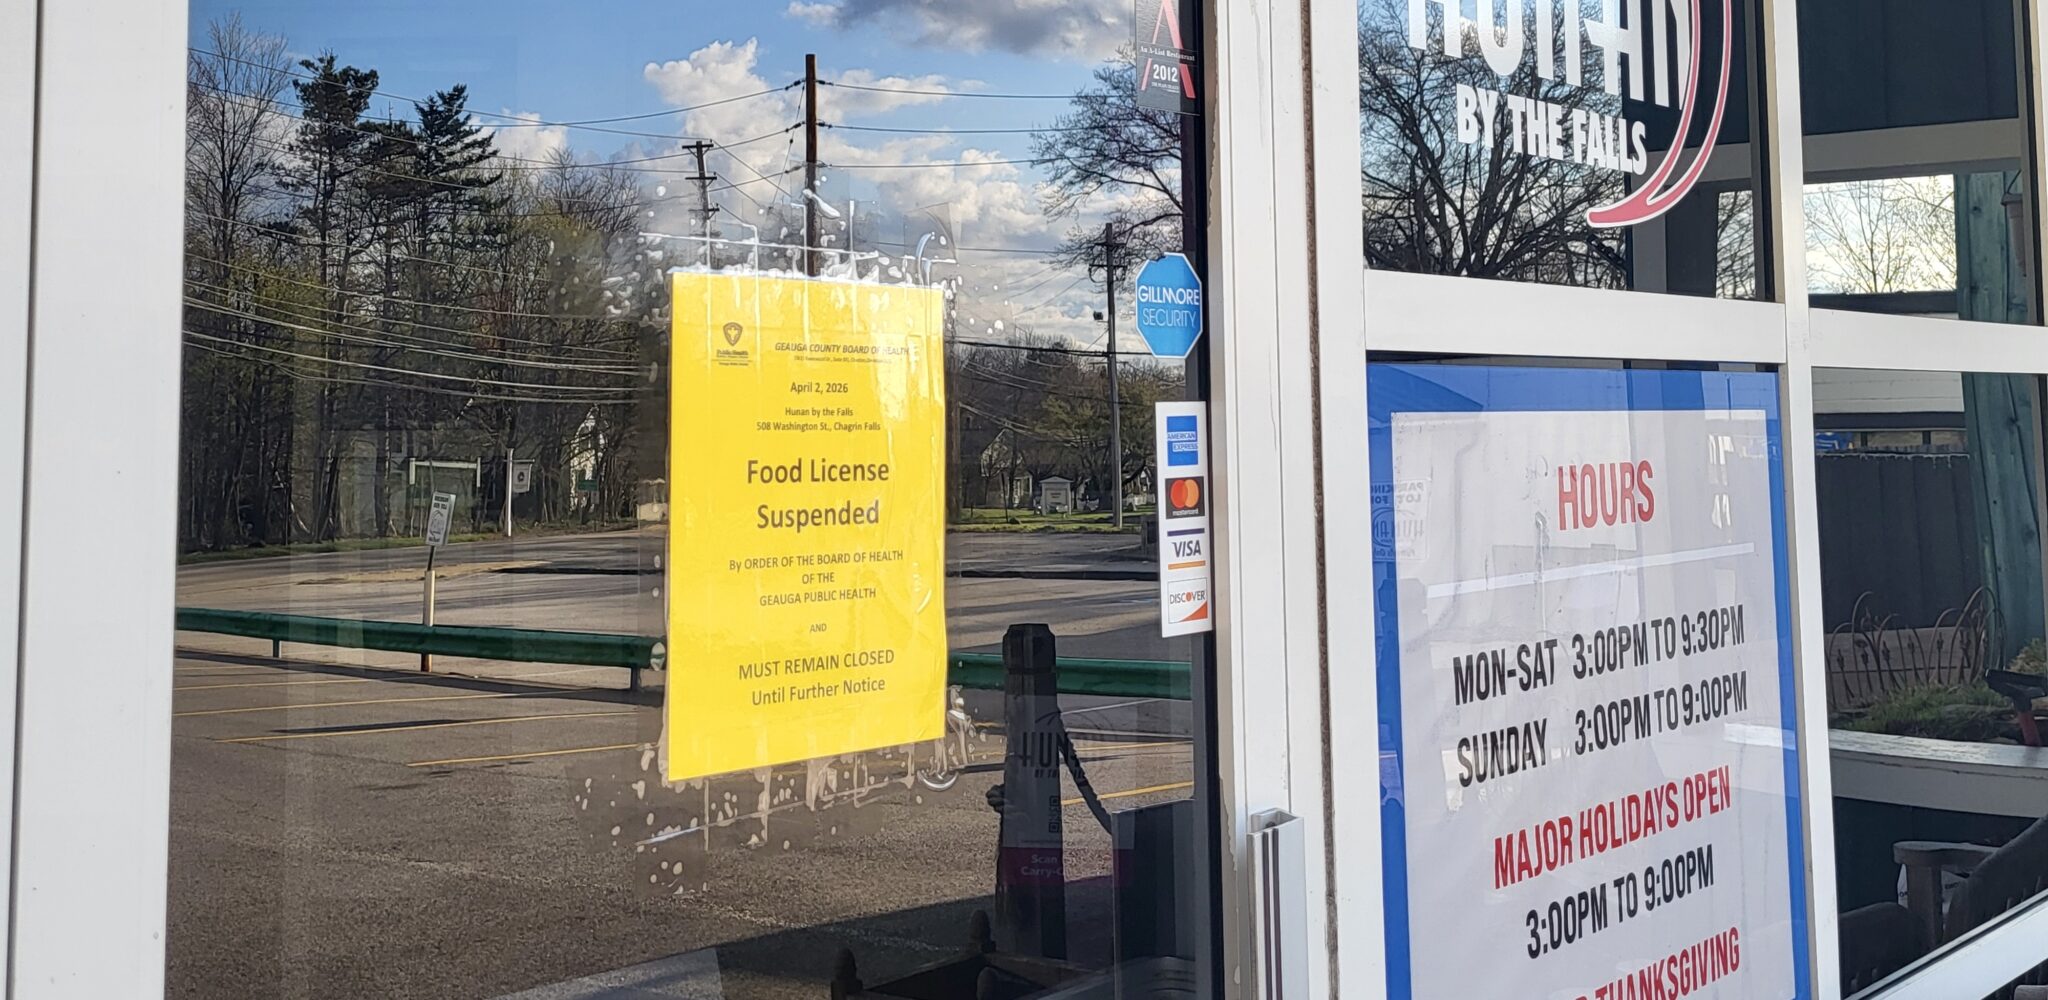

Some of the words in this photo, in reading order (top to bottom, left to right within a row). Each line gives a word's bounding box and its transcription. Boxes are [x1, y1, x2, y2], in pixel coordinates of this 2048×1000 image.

[1166, 49, 1195, 61] Restaurant
[1153, 64, 1178, 82] 2012
[1456, 83, 1499, 149] BY
[1507, 94, 1564, 161] THE
[1572, 107, 1648, 175] FALLS
[1138, 285, 1200, 306] GILLMORE
[1142, 308, 1197, 328] SECURITY
[775, 342, 807, 353] GEAUGA
[809, 343, 841, 355] COUNTY
[842, 344, 869, 355] BOARD
[790, 382, 812, 394] April
[814, 382, 823, 394] 2,
[825, 382, 848, 393] 2026
[785, 407, 808, 417] Hunan
[810, 407, 820, 418] by
[822, 407, 835, 416] the
[837, 407, 854, 417] Falls
[756, 422, 771, 431] 508
[773, 421, 817, 433] Washington
[818, 422, 832, 433] St.,
[834, 421, 861, 433] Chagrin
[863, 421, 881, 431] Falls
[1167, 432, 1195, 440] AMERICAN
[1173, 443, 1199, 451] EXPRESS
[747, 457, 802, 484] Food
[810, 458, 890, 483] License
[1558, 459, 1655, 531] HOURS
[757, 500, 880, 533] Suspended
[1171, 540, 1202, 557] VISA
[729, 560, 741, 572] By
[744, 557, 779, 570] ORDER
[781, 556, 795, 567] OF
[796, 555, 815, 566] THE
[817, 553, 851, 565] BOARD
[853, 552, 867, 563] OF
[869, 550, 904, 562] HEALTH
[802, 573, 815, 585] OF
[817, 572, 835, 583] THE
[759, 593, 801, 607] GEAUGA
[804, 590, 838, 604] PUBLIC
[839, 588, 877, 601] HEALTH
[1170, 590, 1206, 605] DISCOVER
[810, 623, 827, 633] AND
[1452, 638, 1558, 706] MON-SAT
[1571, 620, 1650, 680] 3:00PM
[1651, 616, 1677, 662] TO
[1680, 604, 1745, 657] 9:30PM
[739, 660, 780, 681] MUST
[785, 655, 840, 675] REMAIN
[843, 649, 895, 669] CLOSED
[751, 687, 785, 706] Until
[790, 681, 840, 703] Further
[843, 676, 886, 695] Notice
[1457, 718, 1547, 788] SUNDAY
[1574, 694, 1651, 756] 3:00PM
[1654, 687, 1679, 731] TO
[1682, 671, 1748, 725] 9:00PM
[1494, 813, 1574, 889] MAJOR
[1579, 781, 1679, 859] HOLIDAYS
[1683, 765, 1731, 822] OPEN
[1031, 854, 1058, 863] Scan
[1526, 882, 1608, 960] 3:00PM
[1613, 872, 1639, 924] TO
[1644, 844, 1714, 912] 9:00PM
